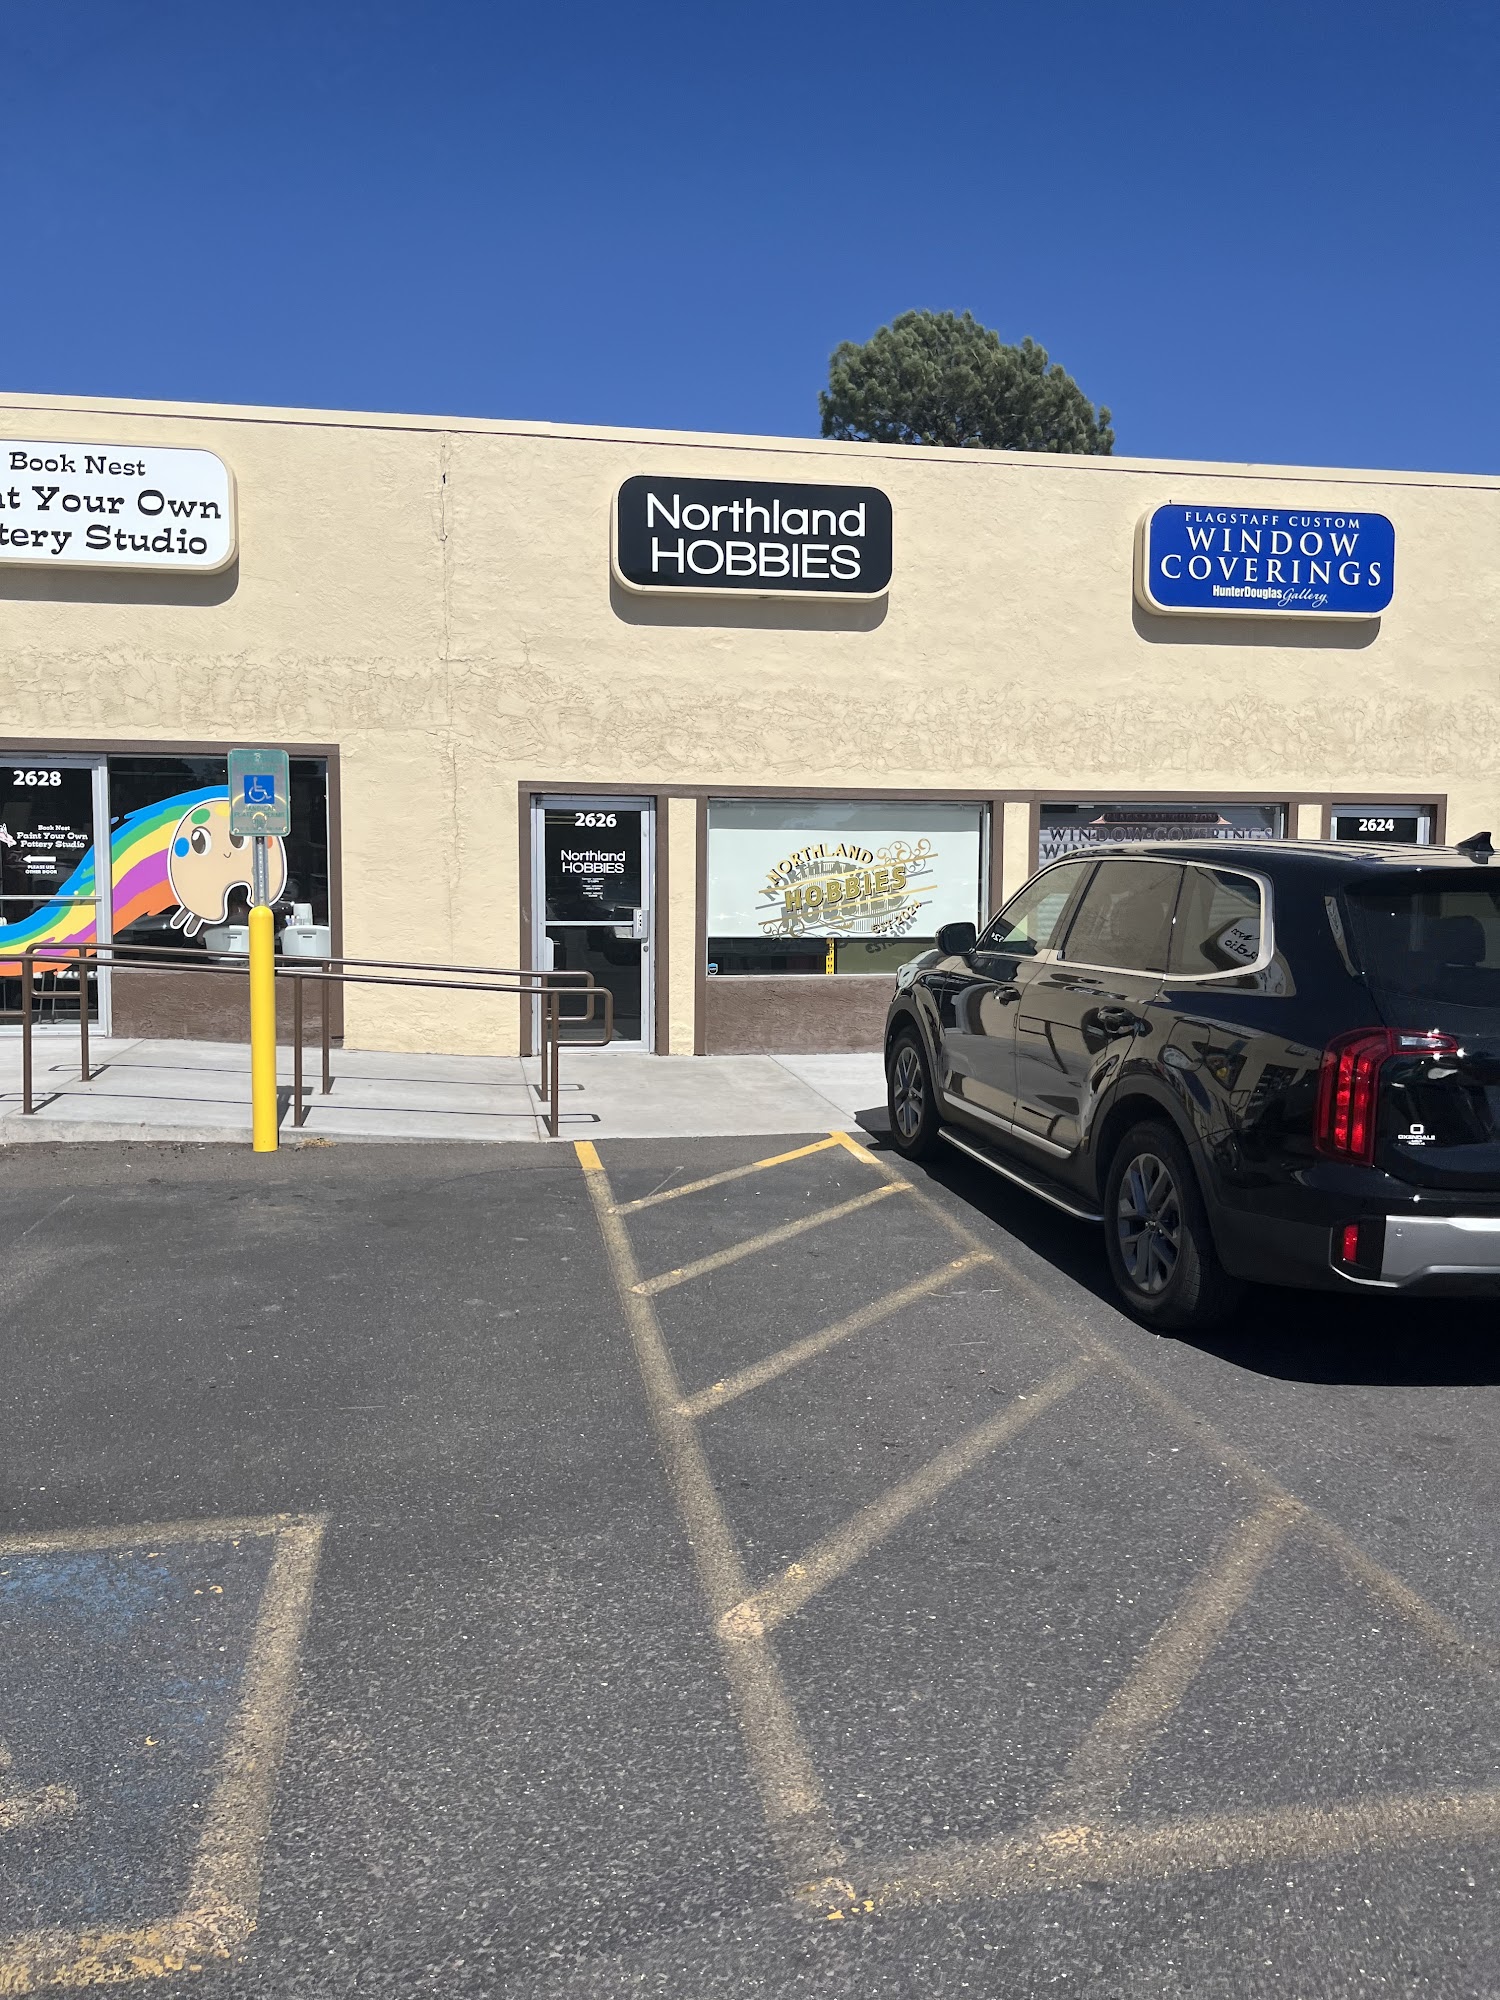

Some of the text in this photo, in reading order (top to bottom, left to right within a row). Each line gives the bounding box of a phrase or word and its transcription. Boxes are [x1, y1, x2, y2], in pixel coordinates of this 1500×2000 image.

[9, 451, 146, 477] Book Nest
[32, 486, 125, 514] Your
[137, 489, 221, 519] Own
[647, 492, 866, 537] Northland
[1185, 511, 1360, 529] FLAGSTAFF CUSTOM
[0, 523, 208, 555] tery Studio
[1186, 526, 1360, 557] WINDOW
[651, 537, 861, 580] HOBBIES
[1160, 554, 1382, 586] COVERINGS
[1277, 587, 1328, 608] Gallery
[13, 770, 61, 787] 2628
[574, 812, 617, 827] 2626
[1358, 819, 1394, 832] 2624
[16, 832, 88, 840] Paint Your Own
[20, 840, 85, 849] Pottery Studio
[1047, 826, 1273, 842] WINDOW COVERINGS
[561, 849, 626, 862] Northland
[765, 843, 874, 886] NORTHLAND
[562, 862, 625, 874] HOBBIES
[784, 866, 907, 912] HOBBIES
[895, 899, 922, 926] 2024
